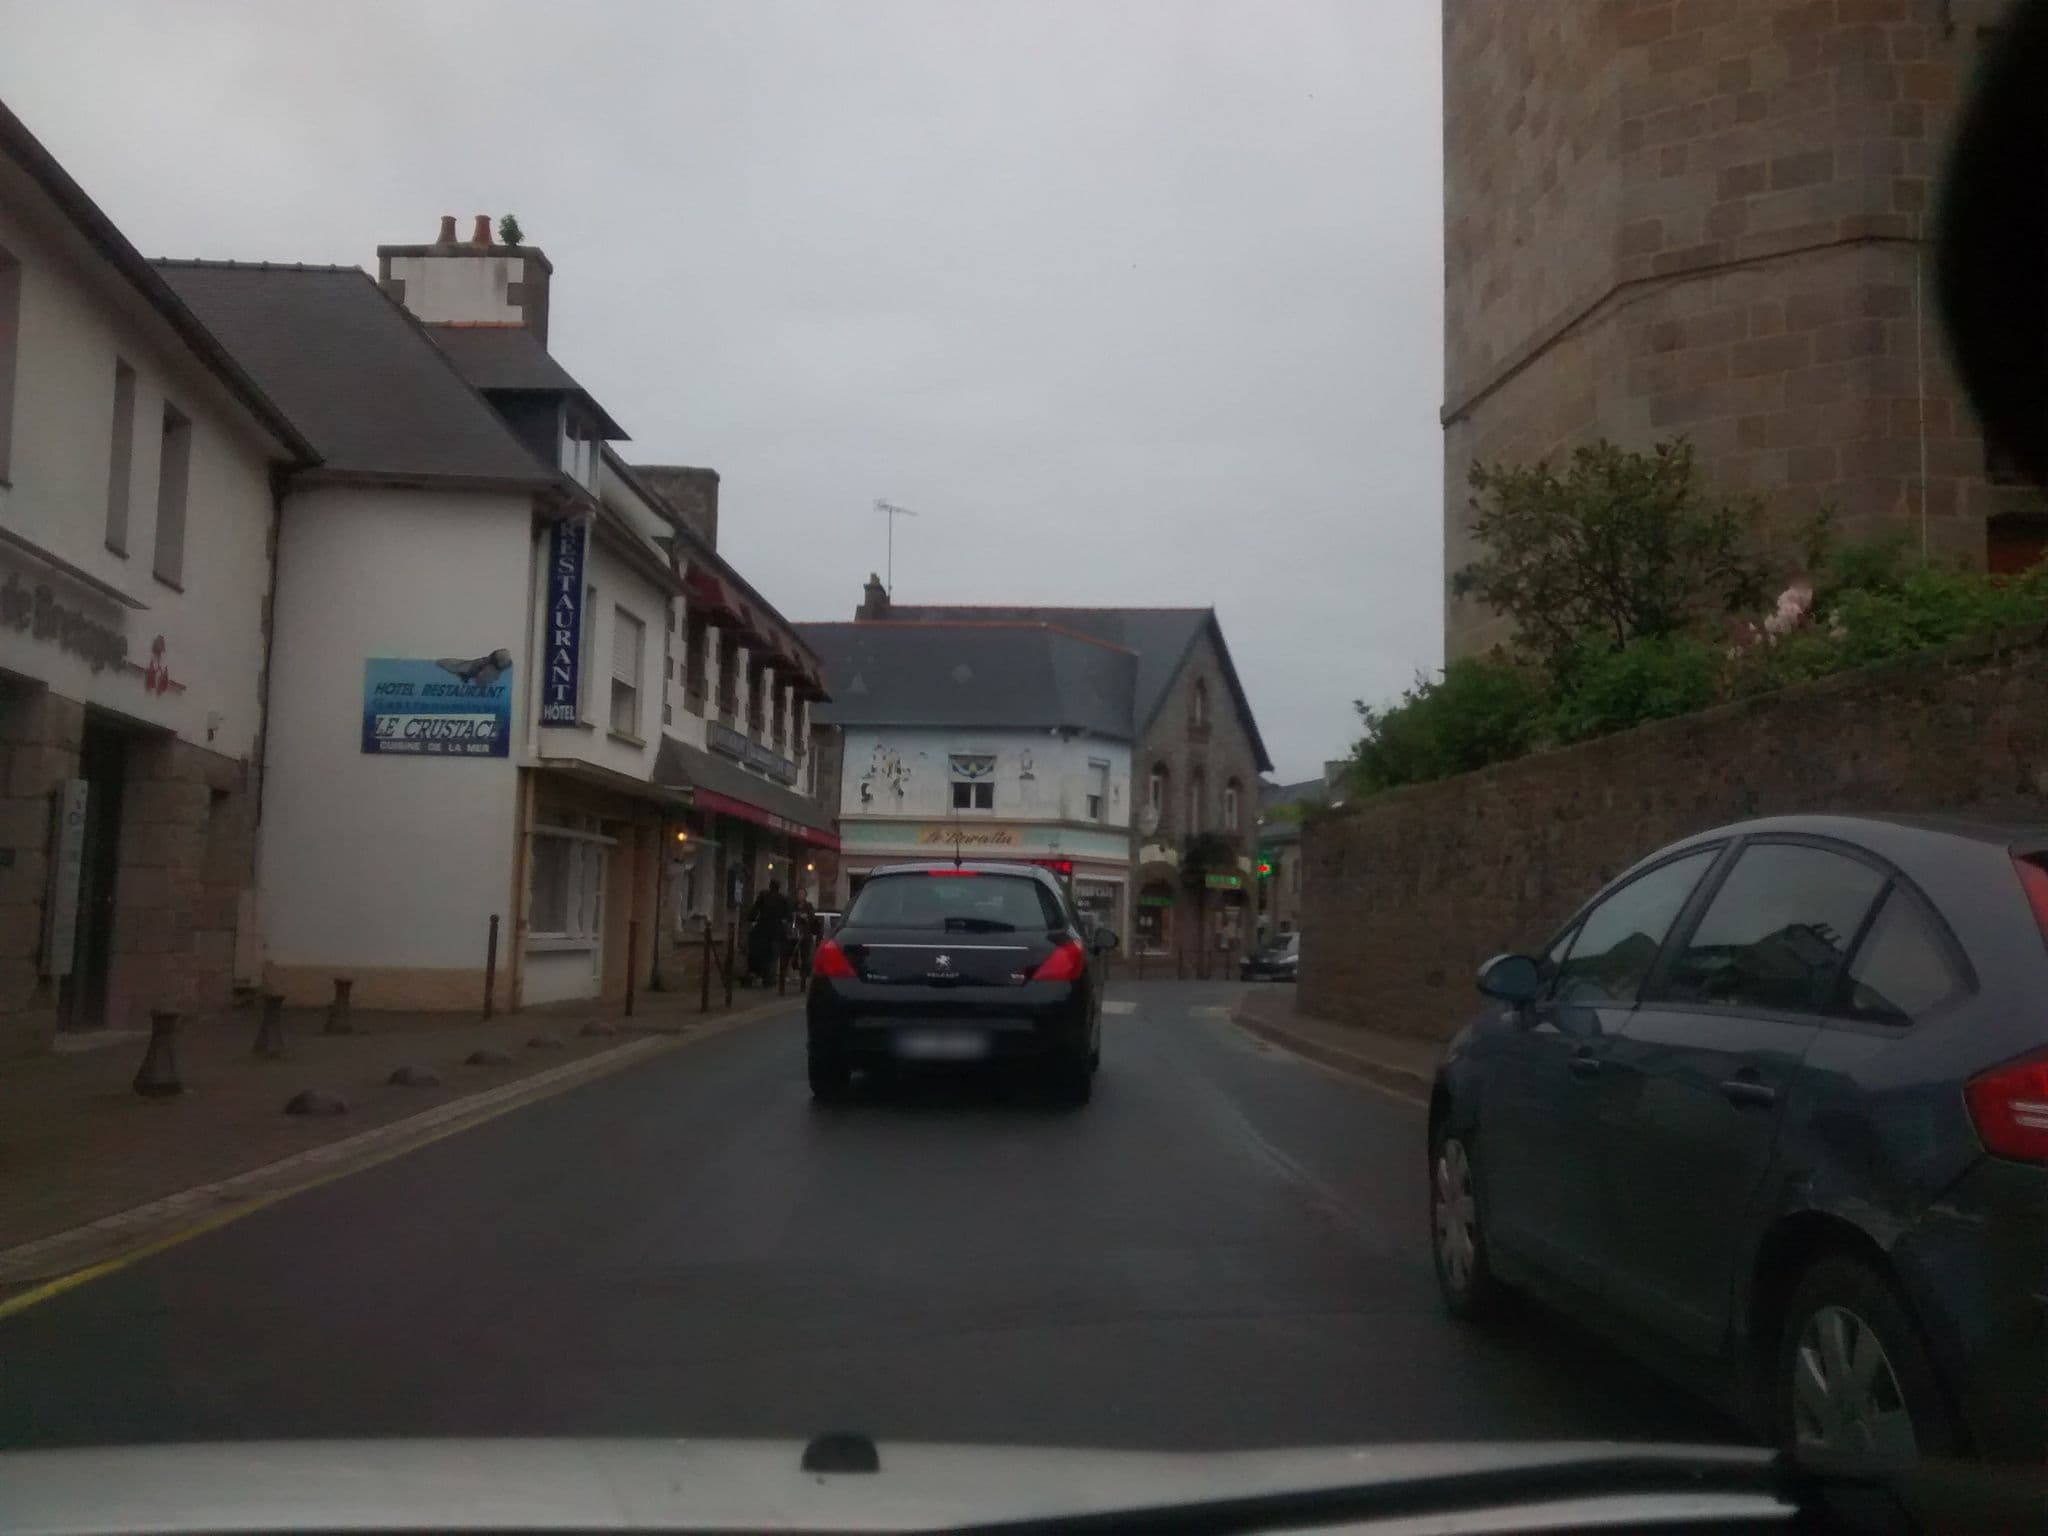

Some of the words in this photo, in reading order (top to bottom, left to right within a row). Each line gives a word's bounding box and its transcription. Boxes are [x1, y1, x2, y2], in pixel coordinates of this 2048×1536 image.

[552, 520, 577, 701] RESTAURANT
[421, 683, 505, 698] RESTAURANT
[375, 717, 400, 738] LE
[428, 742, 441, 752] DE
[448, 743, 461, 752] LA
[467, 744, 489, 753] MER
